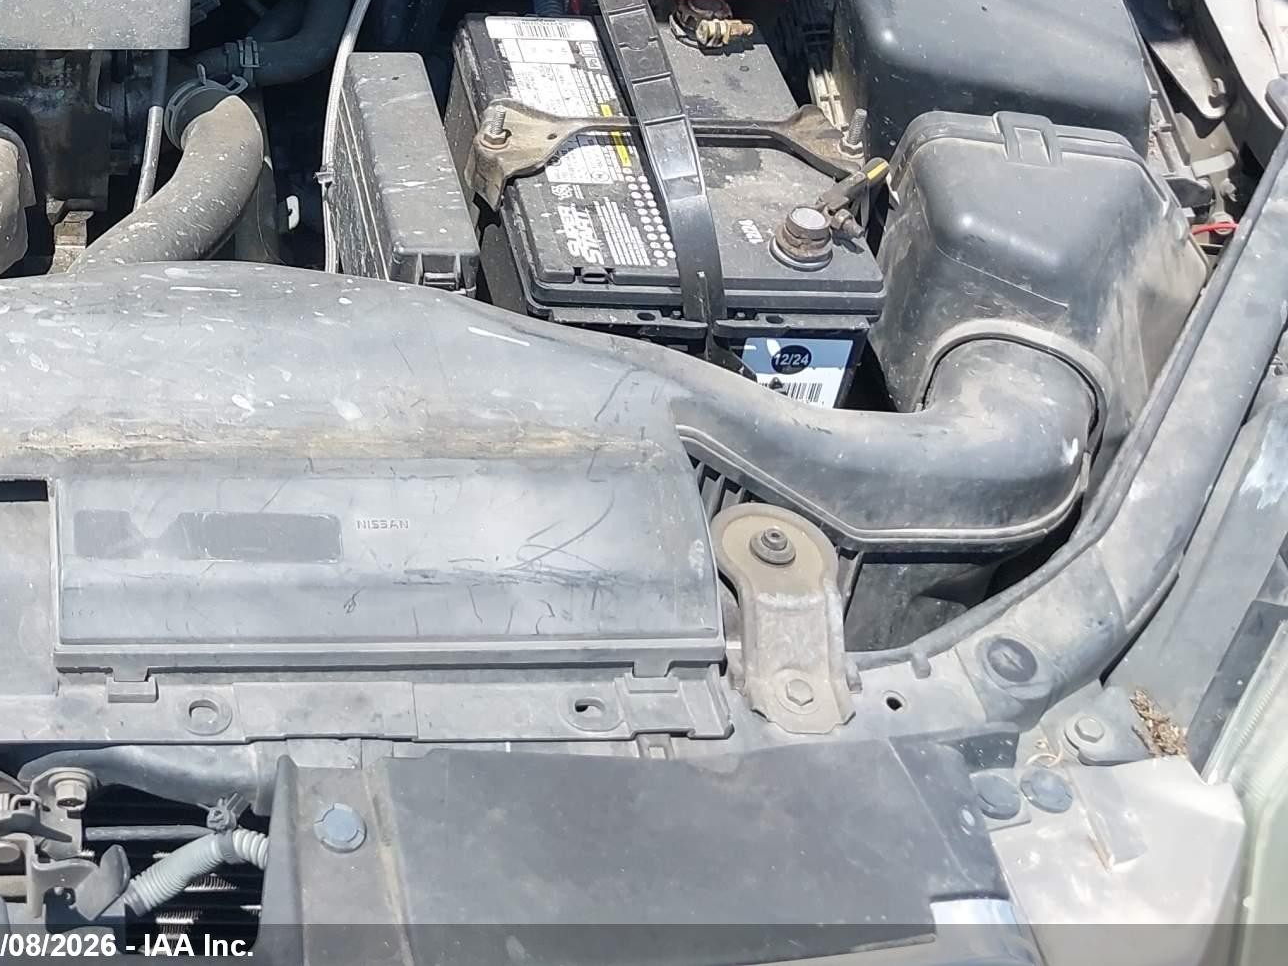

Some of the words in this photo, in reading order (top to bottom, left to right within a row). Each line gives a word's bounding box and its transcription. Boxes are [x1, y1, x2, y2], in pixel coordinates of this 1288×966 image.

[557, 204, 581, 257] SUPER
[574, 208, 604, 265] START
[773, 353, 809, 366] 12/24
[356, 519, 409, 529] NISSAN
